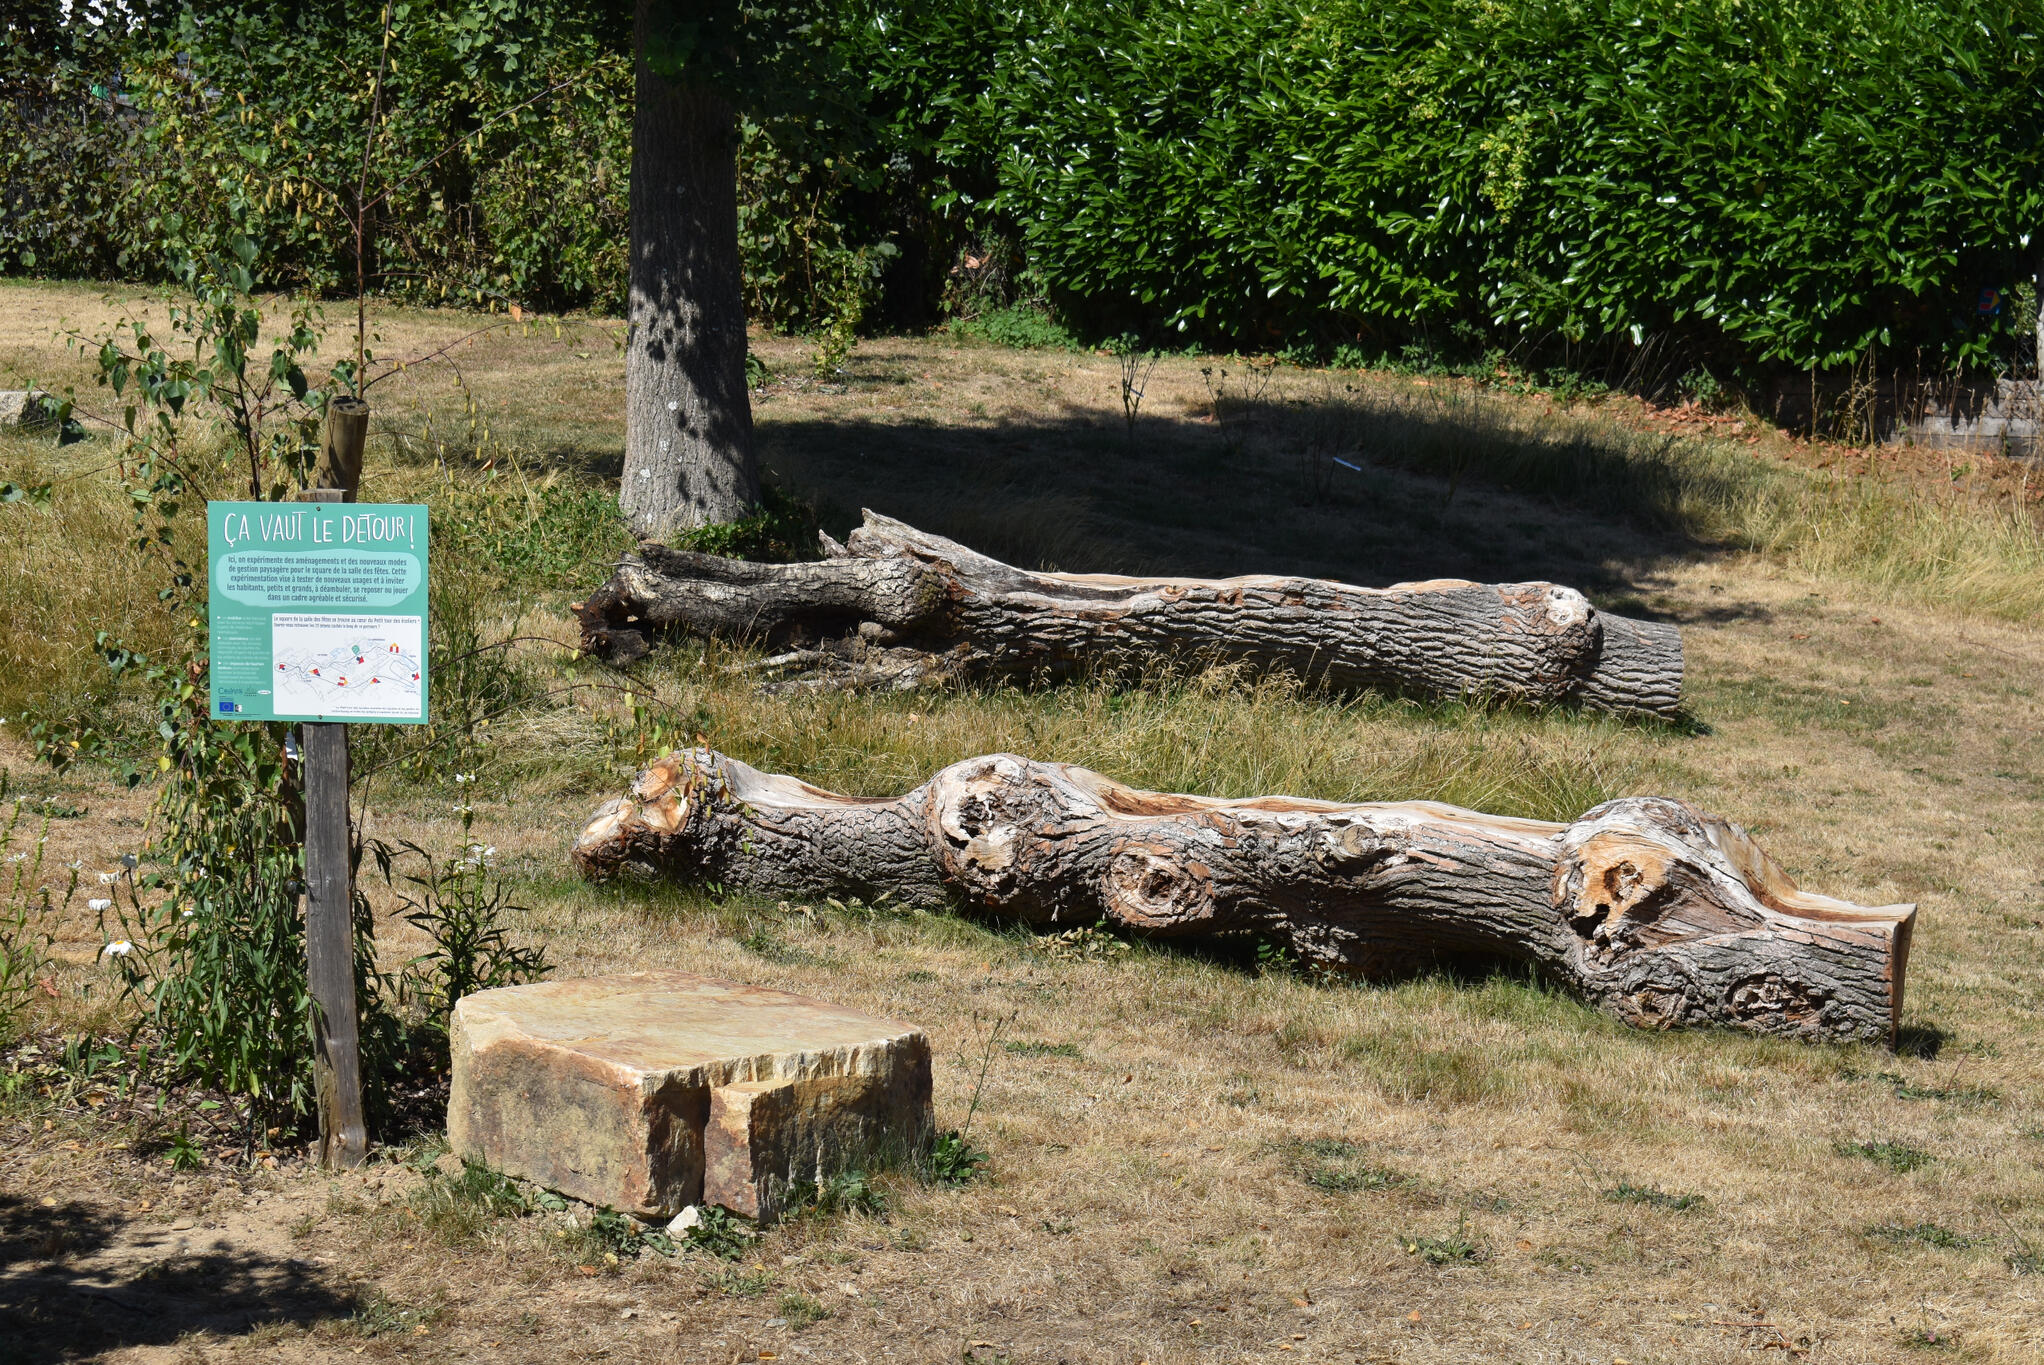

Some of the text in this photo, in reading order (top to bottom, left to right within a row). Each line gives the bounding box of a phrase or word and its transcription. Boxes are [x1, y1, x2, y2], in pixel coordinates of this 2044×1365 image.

[224, 512, 250, 548] ÇA
[259, 511, 308, 543] VAUT
[312, 516, 334, 544] LE
[247, 556, 282, 565] expérimente
[284, 556, 294, 564] des
[296, 557, 339, 566] aménagements
[260, 566, 288, 574] paysagère
[231, 574, 278, 583] expérimentation
[393, 587, 408, 595] jouer
[308, 594, 334, 603] agréable
